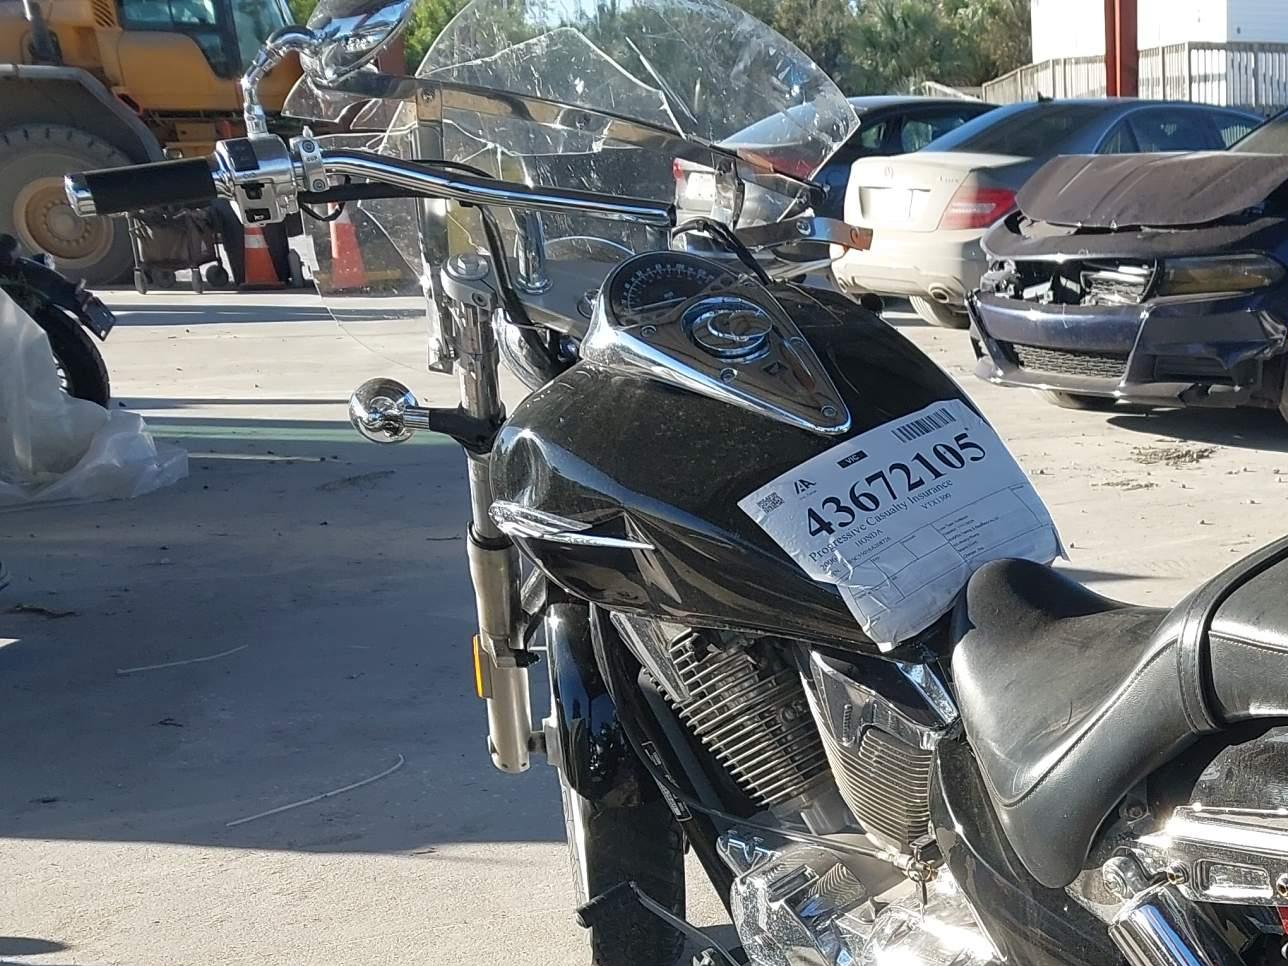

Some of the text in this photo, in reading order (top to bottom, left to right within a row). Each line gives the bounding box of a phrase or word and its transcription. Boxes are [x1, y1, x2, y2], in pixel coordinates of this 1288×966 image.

[807, 432, 986, 537] 43672105
[809, 524, 867, 562] Progressive
[866, 499, 908, 526] Casualty
[907, 480, 953, 504] Insurance
[855, 528, 884, 548] HONDA
